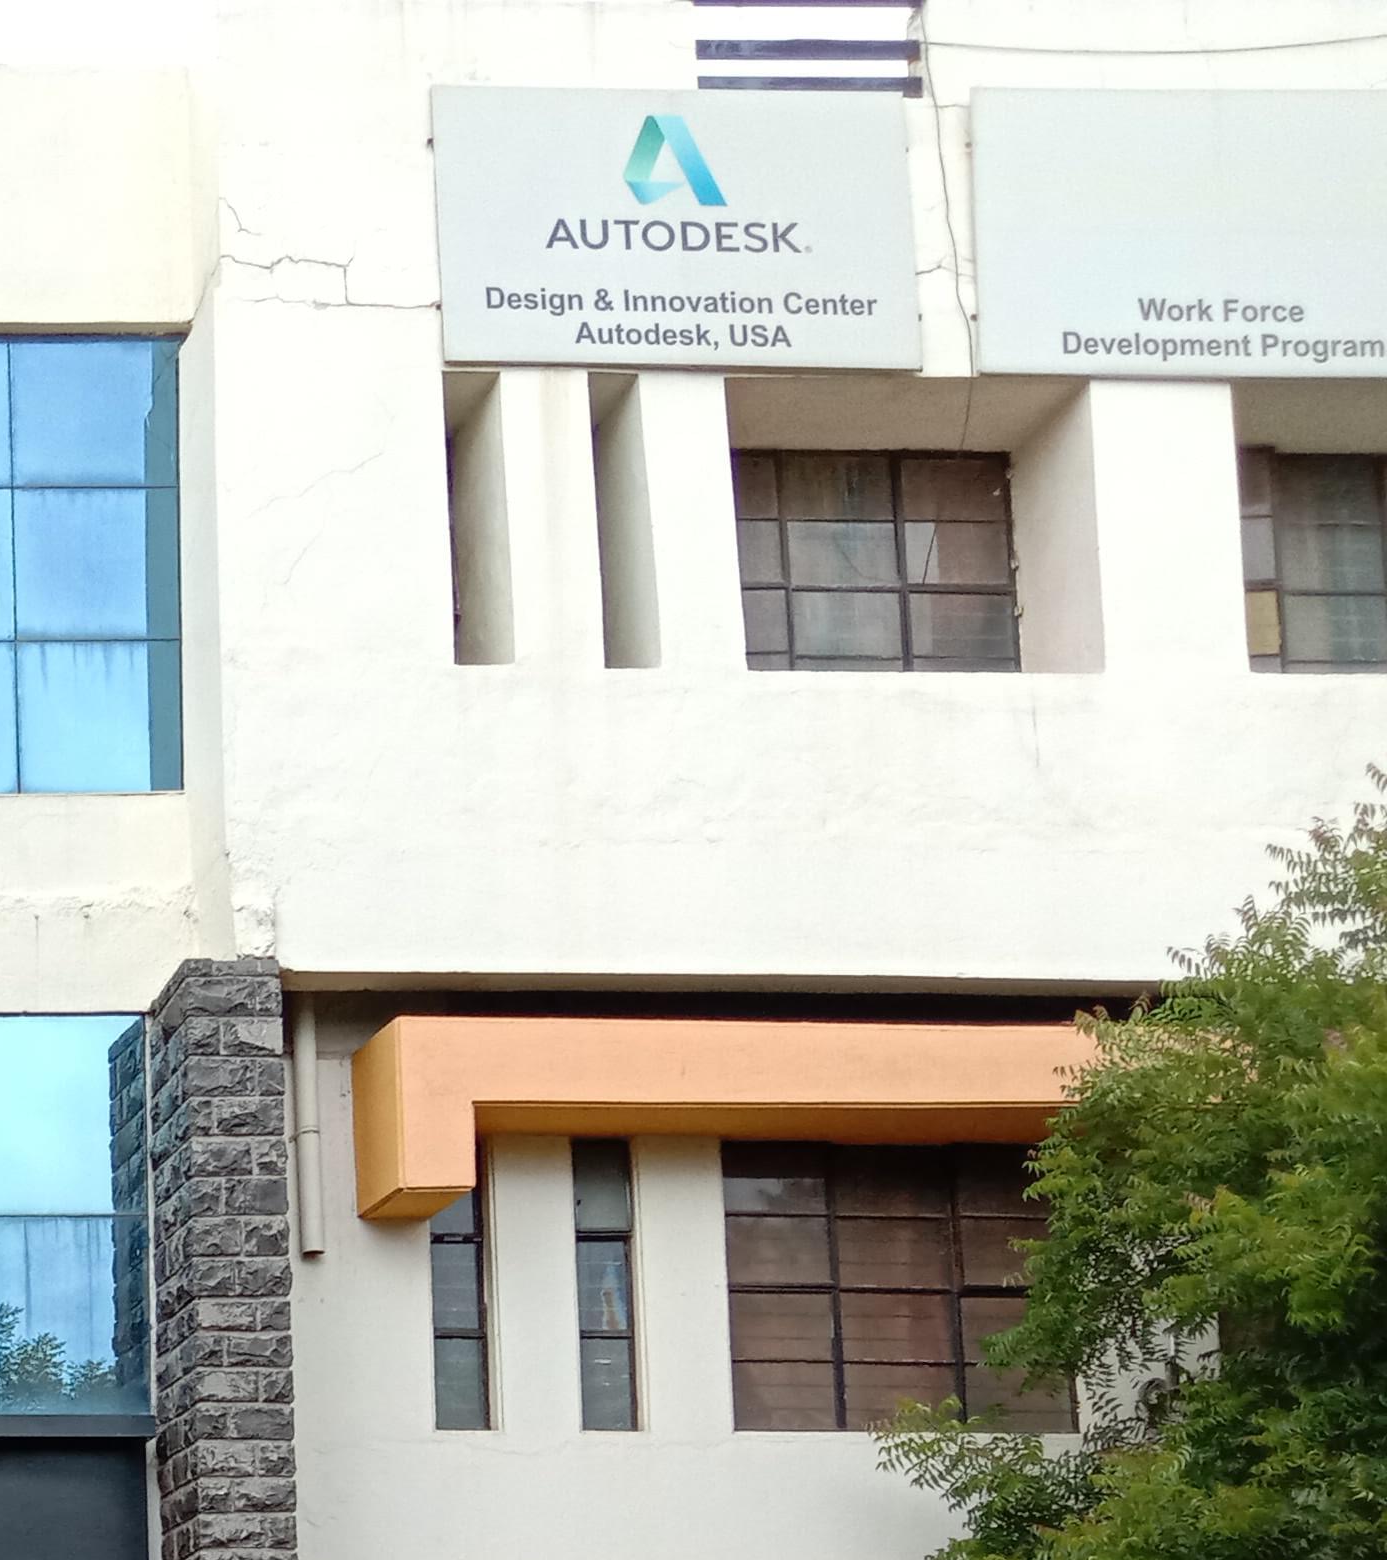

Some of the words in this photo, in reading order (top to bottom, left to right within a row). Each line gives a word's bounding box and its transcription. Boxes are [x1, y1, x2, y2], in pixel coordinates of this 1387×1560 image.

[545, 218, 801, 254] AUTODESK
[485, 286, 583, 317] Design
[594, 288, 614, 312] &
[623, 289, 773, 315] Innovation
[783, 292, 877, 316] Center
[1137, 297, 1214, 323] Work
[1222, 299, 1304, 323] Force
[575, 321, 719, 351] Autodesk,
[729, 324, 792, 348] USA
[1062, 331, 1252, 362] Development
[1261, 333, 1385, 364] Program
